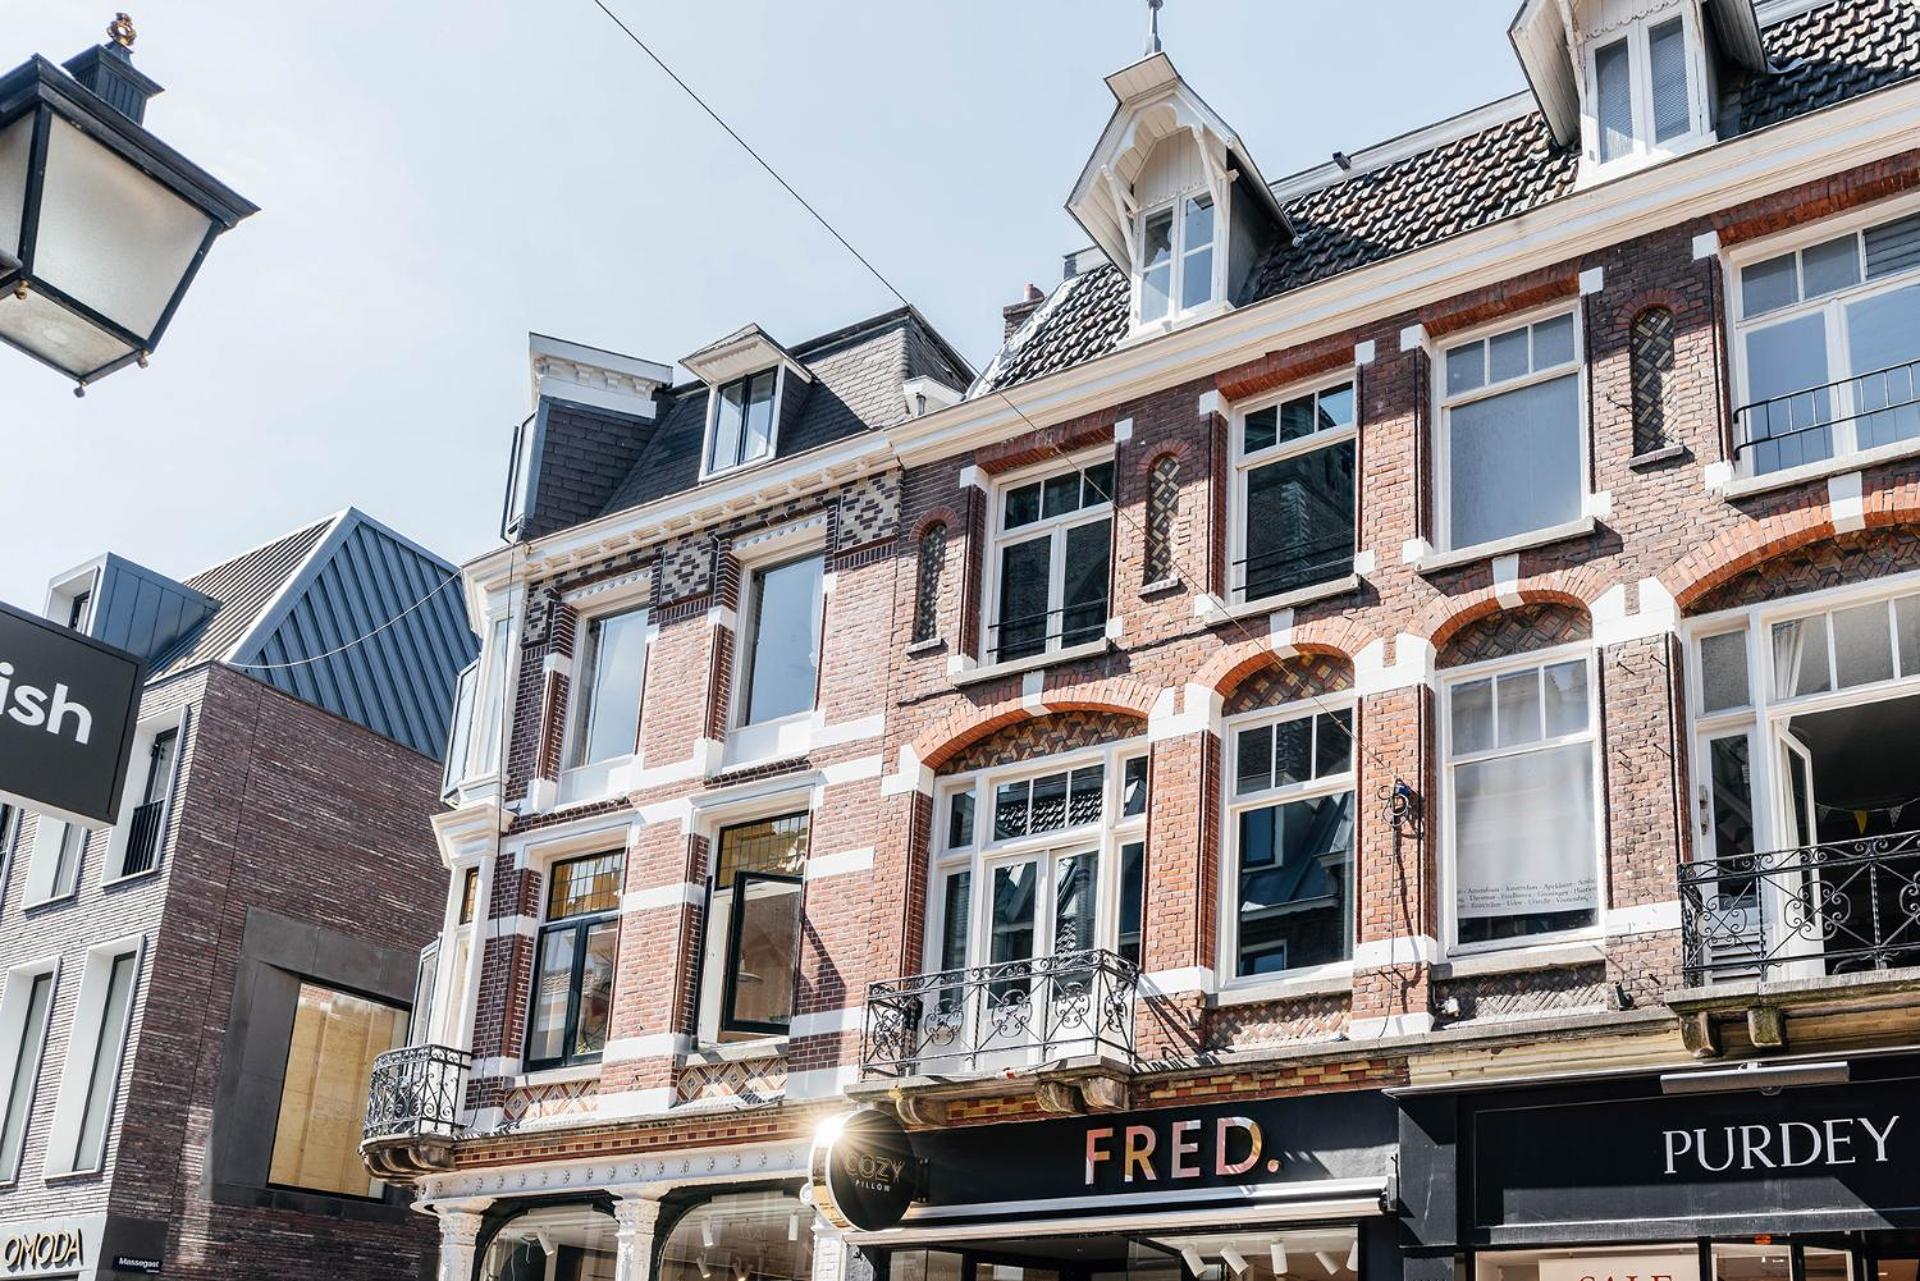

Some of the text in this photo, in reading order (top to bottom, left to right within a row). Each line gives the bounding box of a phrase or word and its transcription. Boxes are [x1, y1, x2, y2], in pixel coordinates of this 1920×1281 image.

[1085, 1116, 1280, 1185] FRED.
[1662, 1115, 1900, 1174] PURDEY
[844, 1151, 905, 1183] COZY
[855, 1179, 891, 1192] PILLOW
[5, 1228, 84, 1271] OMODA
